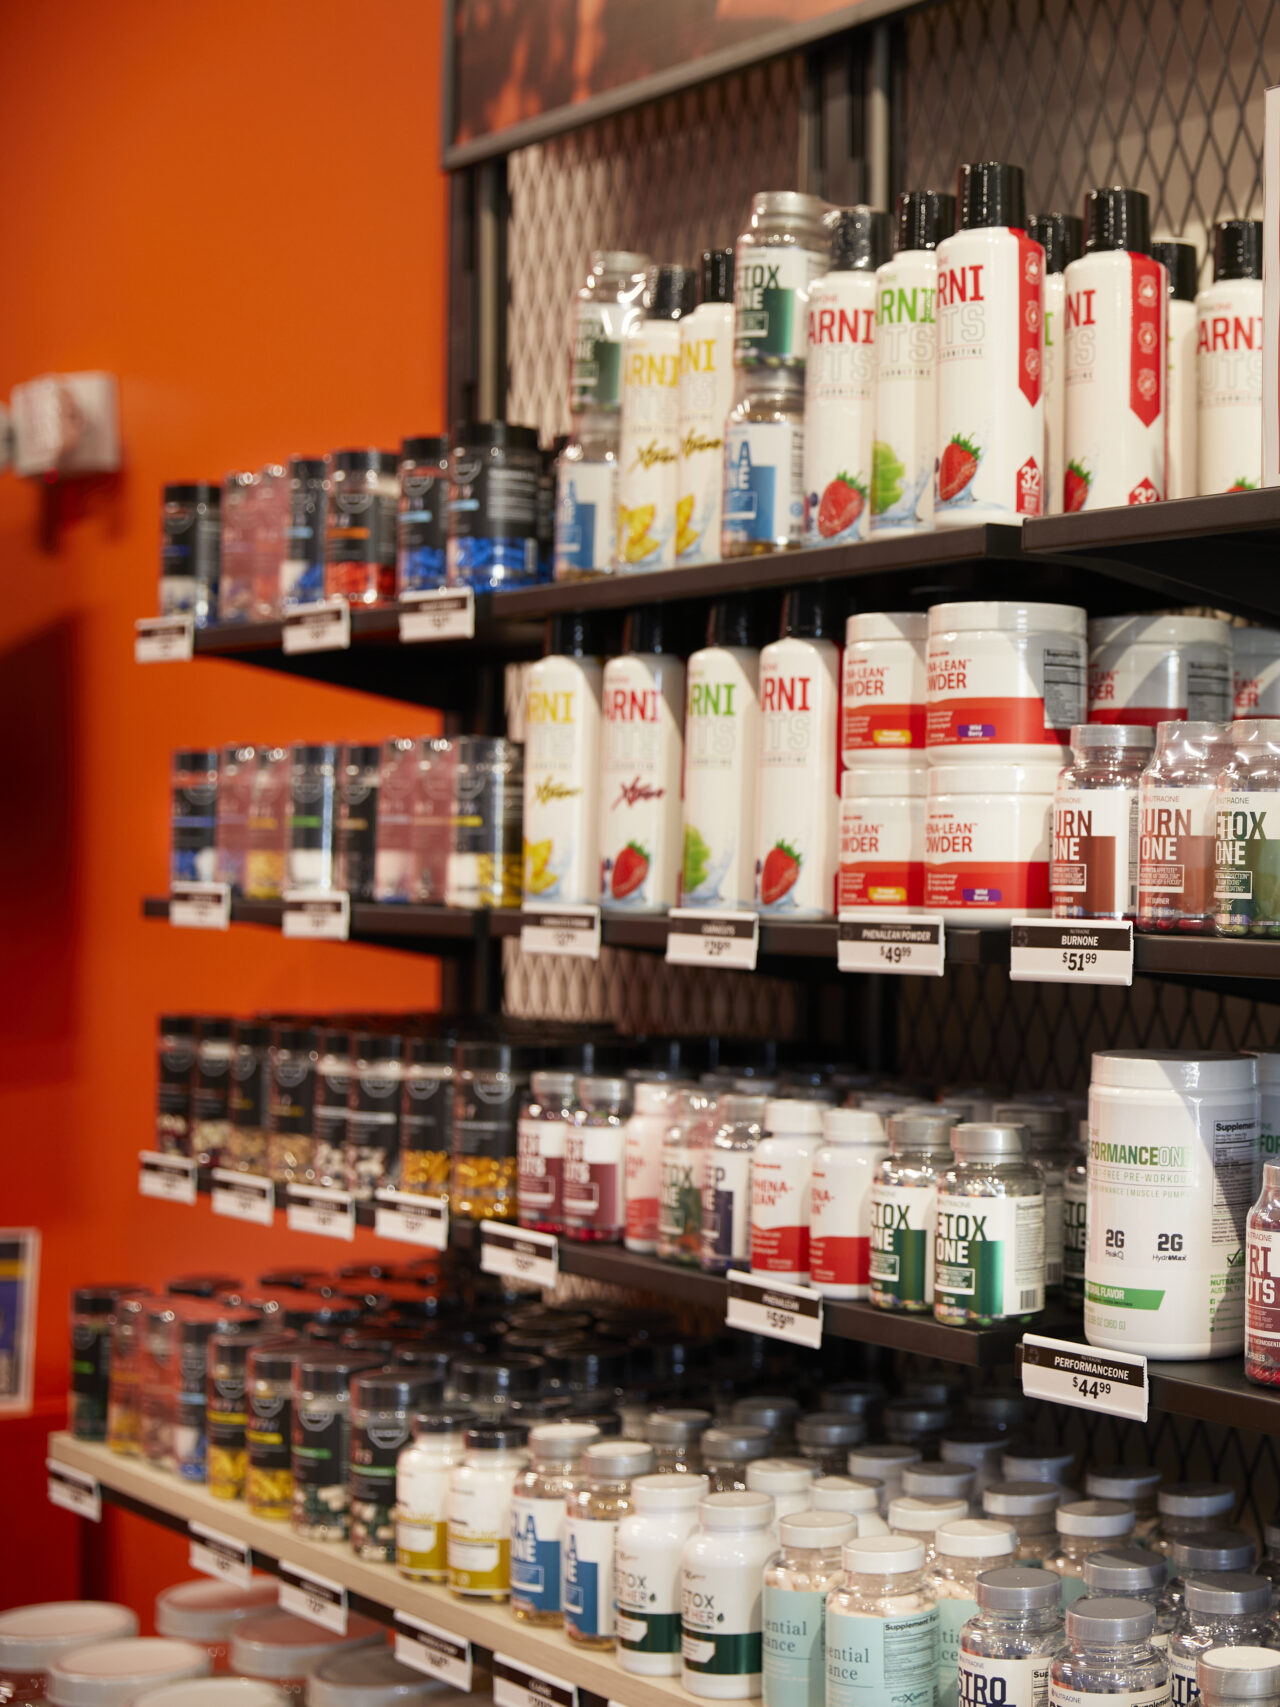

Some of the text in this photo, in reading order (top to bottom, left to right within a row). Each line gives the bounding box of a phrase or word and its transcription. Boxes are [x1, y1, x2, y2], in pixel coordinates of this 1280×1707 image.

[877, 288, 936, 327] RNI
[1021, 466, 1039, 489] 32
[1142, 837, 1177, 861] ONE
[1215, 841, 1246, 865] ONE
[1061, 935, 1098, 947] BURNONE
[1105, 1229, 1125, 1249] 2G
[1157, 1233, 1183, 1252] 2G
[936, 1240, 969, 1264] ONE
[1100, 1288, 1125, 1300] FLAVOR
[1054, 1357, 1130, 1381] PERFORMANCEONE
[885, 1619, 929, 1631] Supplement
